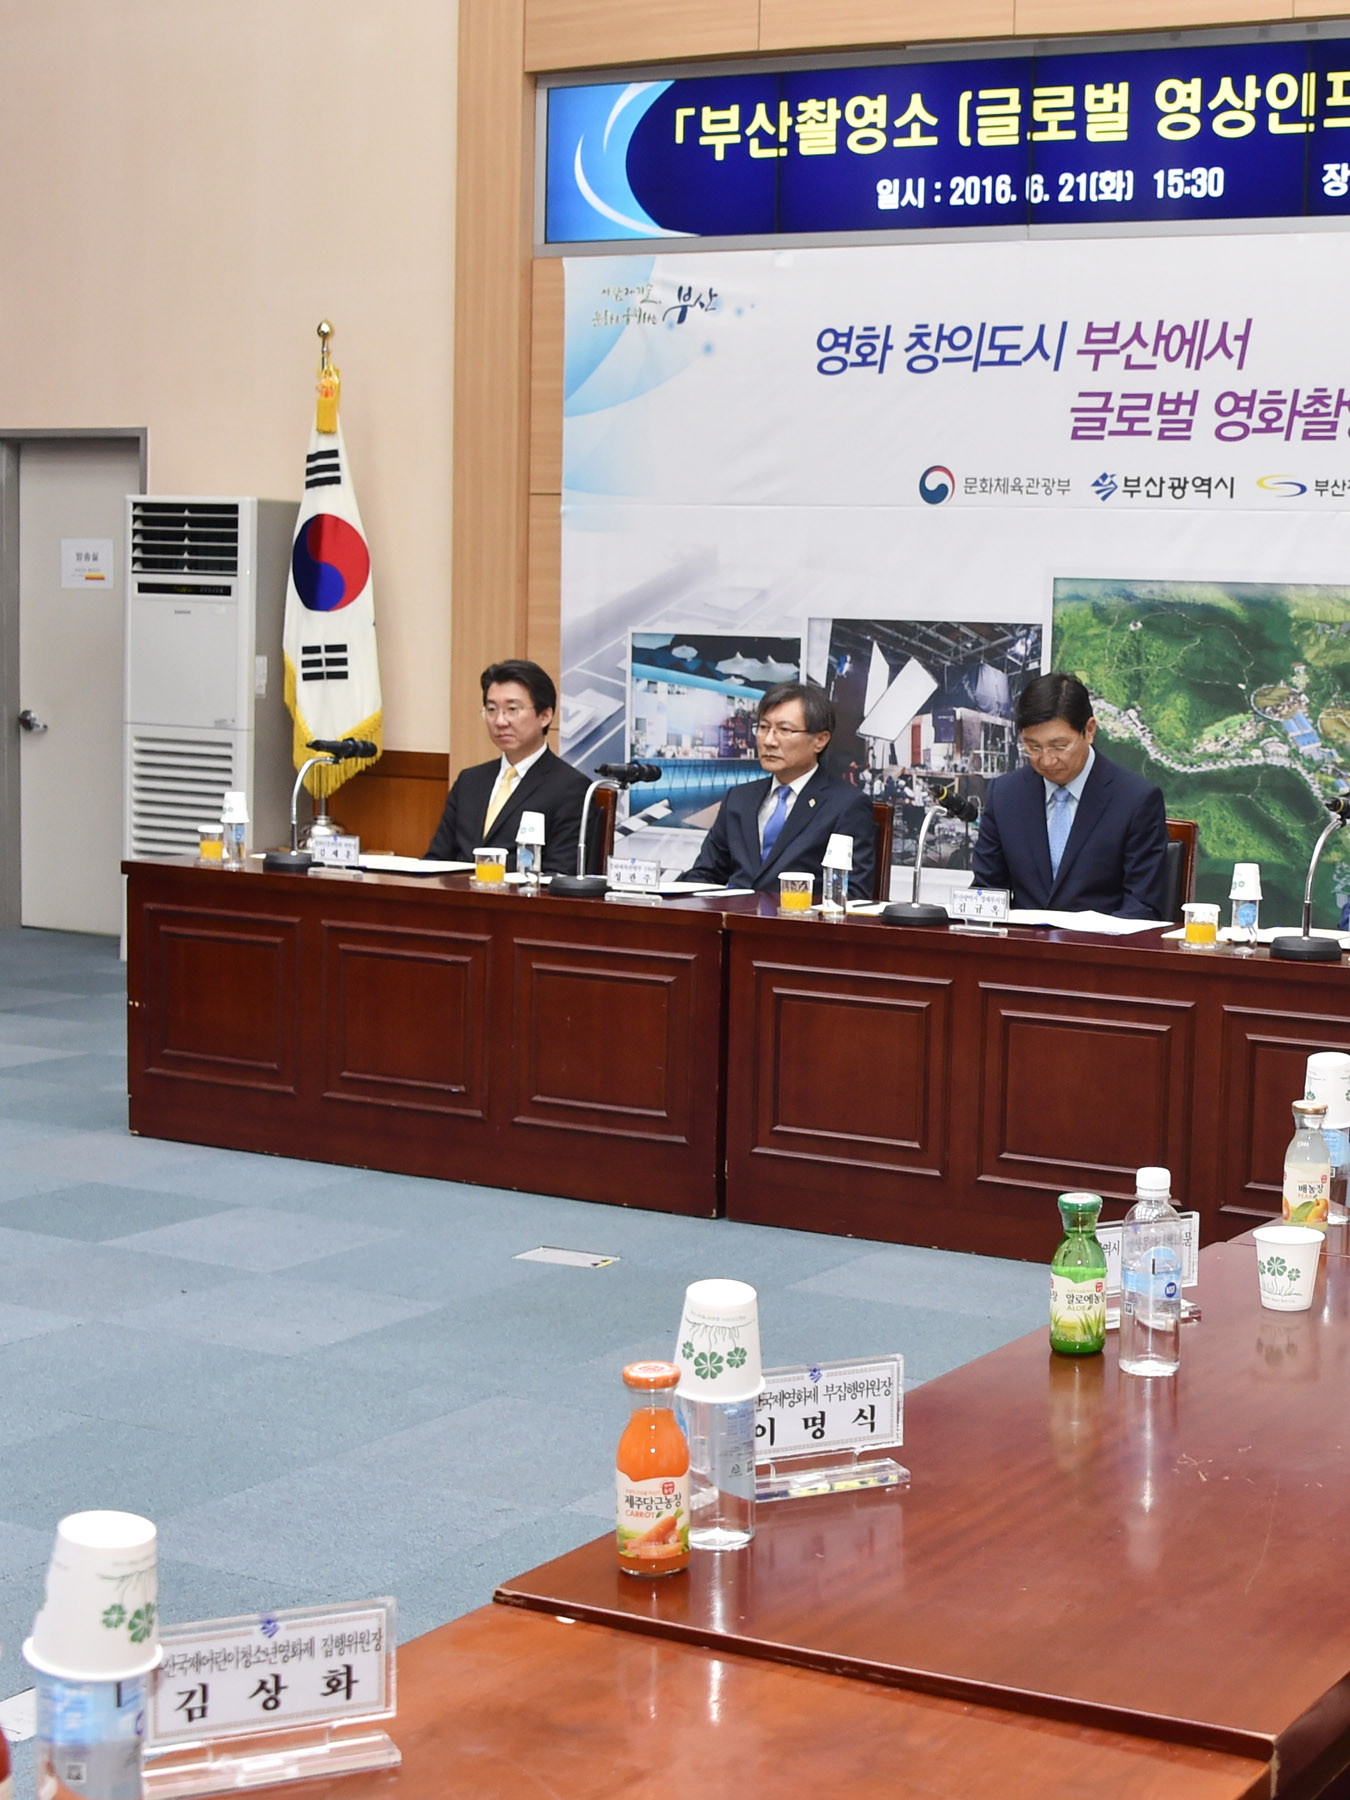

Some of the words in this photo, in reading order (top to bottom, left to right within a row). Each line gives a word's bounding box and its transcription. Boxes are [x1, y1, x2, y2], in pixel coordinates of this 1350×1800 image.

[876, 177, 926, 210] 일시
[949, 174, 1018, 206] 2016.
[1153, 166, 1226, 199] 15:30
[662, 285, 719, 325] 부산
[815, 325, 894, 375] 영화
[903, 321, 1068, 374] 창의도시
[1076, 317, 1254, 372] 부산에서
[1069, 389, 1200, 442] 글로벌
[963, 476, 1072, 496] 문화체육관광부
[1121, 475, 1235, 500] 부산광역시
[1298, 1184, 1324, 1194] 배농장
[822, 1376, 893, 1403] 부집행위원장
[624, 1492, 682, 1511] 제주당근농장
[625, 1510, 656, 1519] CARROT
[321, 1627, 384, 1660] 집행위원장
